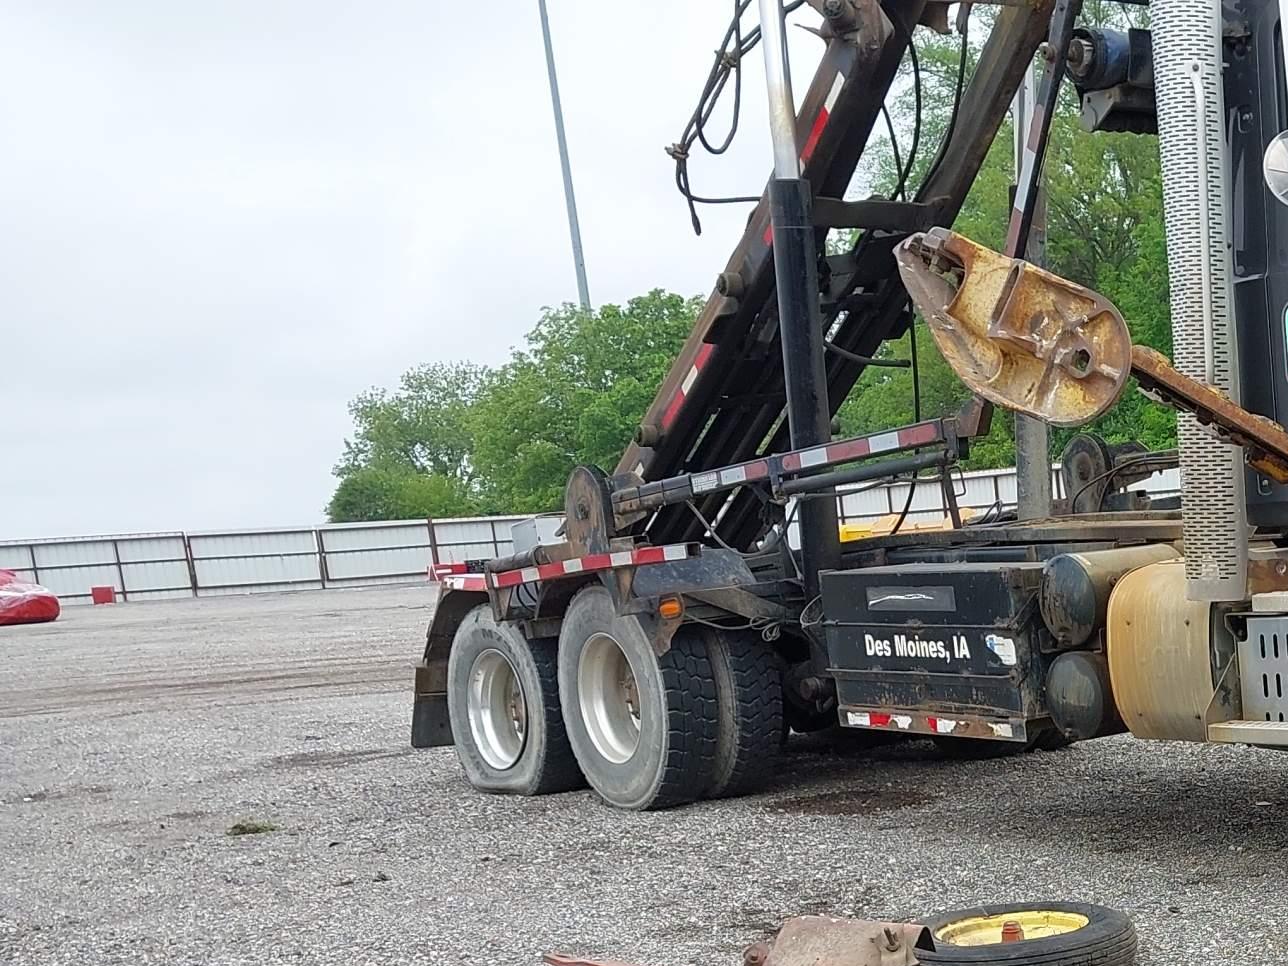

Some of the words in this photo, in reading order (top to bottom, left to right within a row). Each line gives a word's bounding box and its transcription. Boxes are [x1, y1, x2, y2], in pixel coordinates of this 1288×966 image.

[864, 634, 892, 656] Des
[893, 634, 951, 664] Moines,
[952, 635, 971, 659] IA
